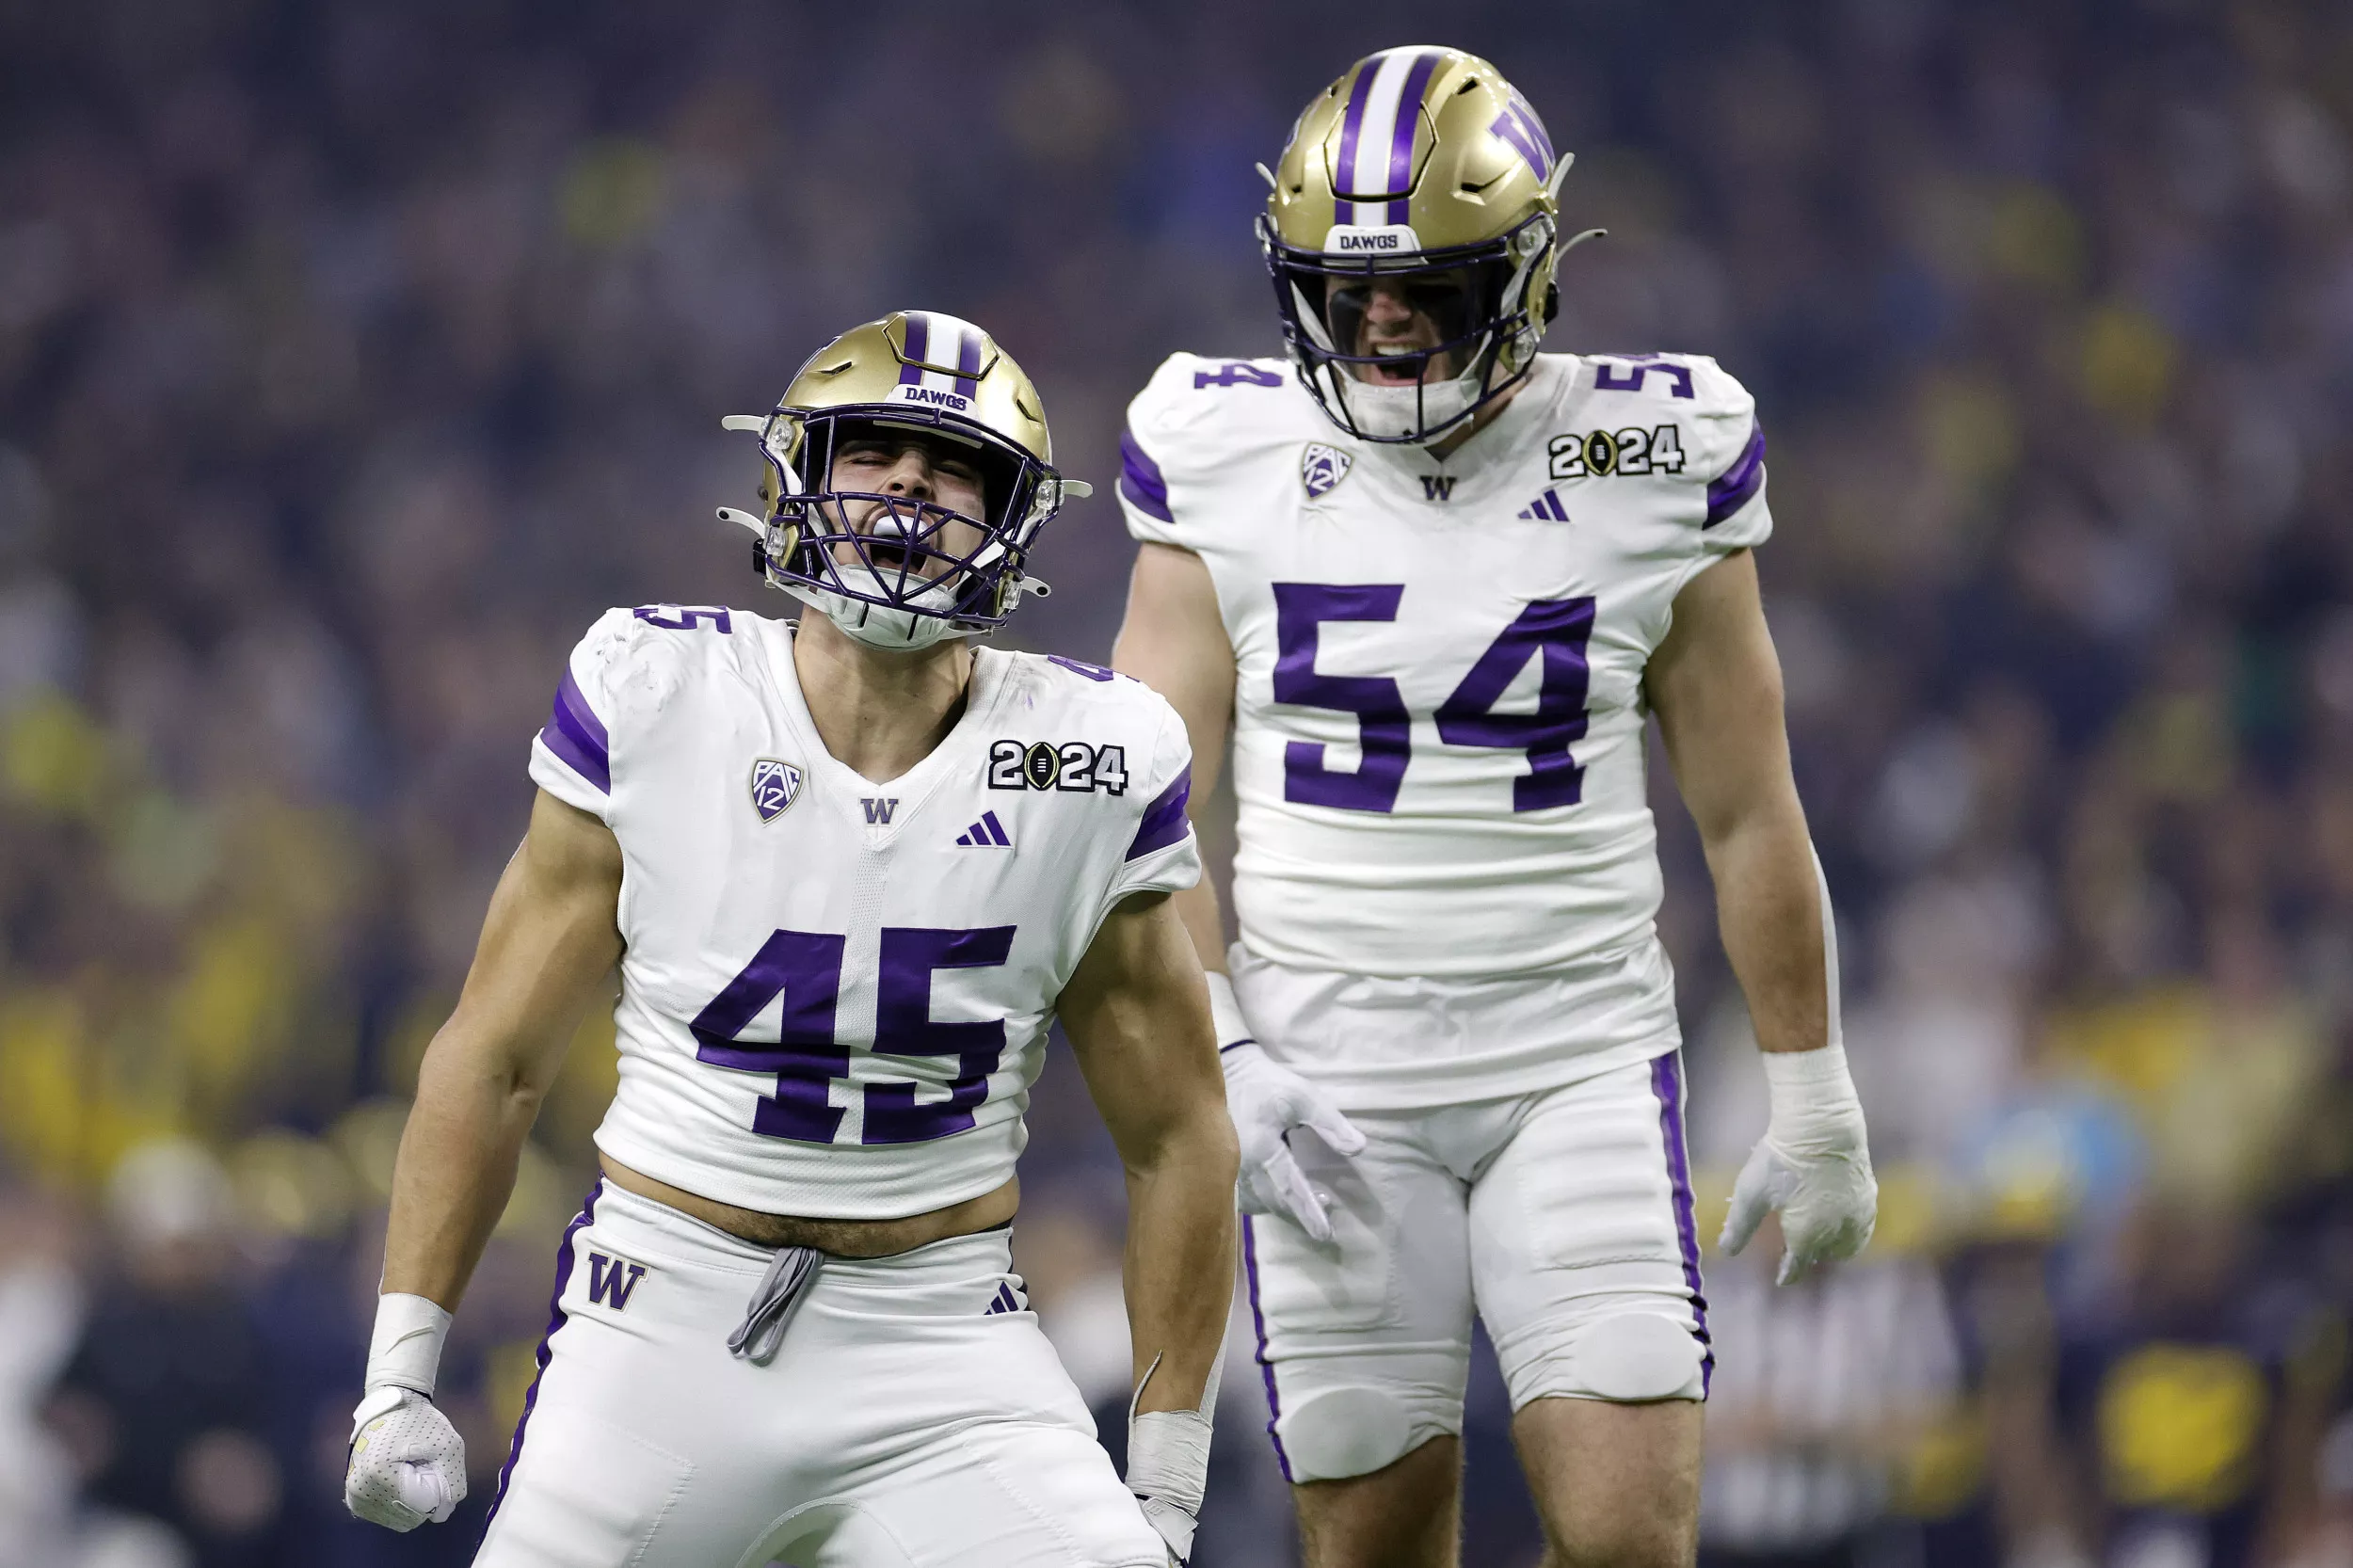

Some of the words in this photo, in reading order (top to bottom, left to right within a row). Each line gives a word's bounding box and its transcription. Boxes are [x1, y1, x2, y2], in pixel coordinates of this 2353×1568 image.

[1339, 234, 1399, 250] DAWGS
[904, 387, 968, 411] DAWGS
[1304, 444, 1353, 484] PAC
[1548, 424, 1687, 480] 2024
[1305, 467, 1334, 491] 12
[1419, 475, 1457, 501] W
[1271, 582, 1596, 813] 54
[753, 760, 802, 803] PAC
[988, 740, 1128, 796] 2024
[757, 785, 783, 811] 12
[860, 798, 900, 824] W
[688, 924, 1017, 1144] 45
[587, 1251, 649, 1312] W
